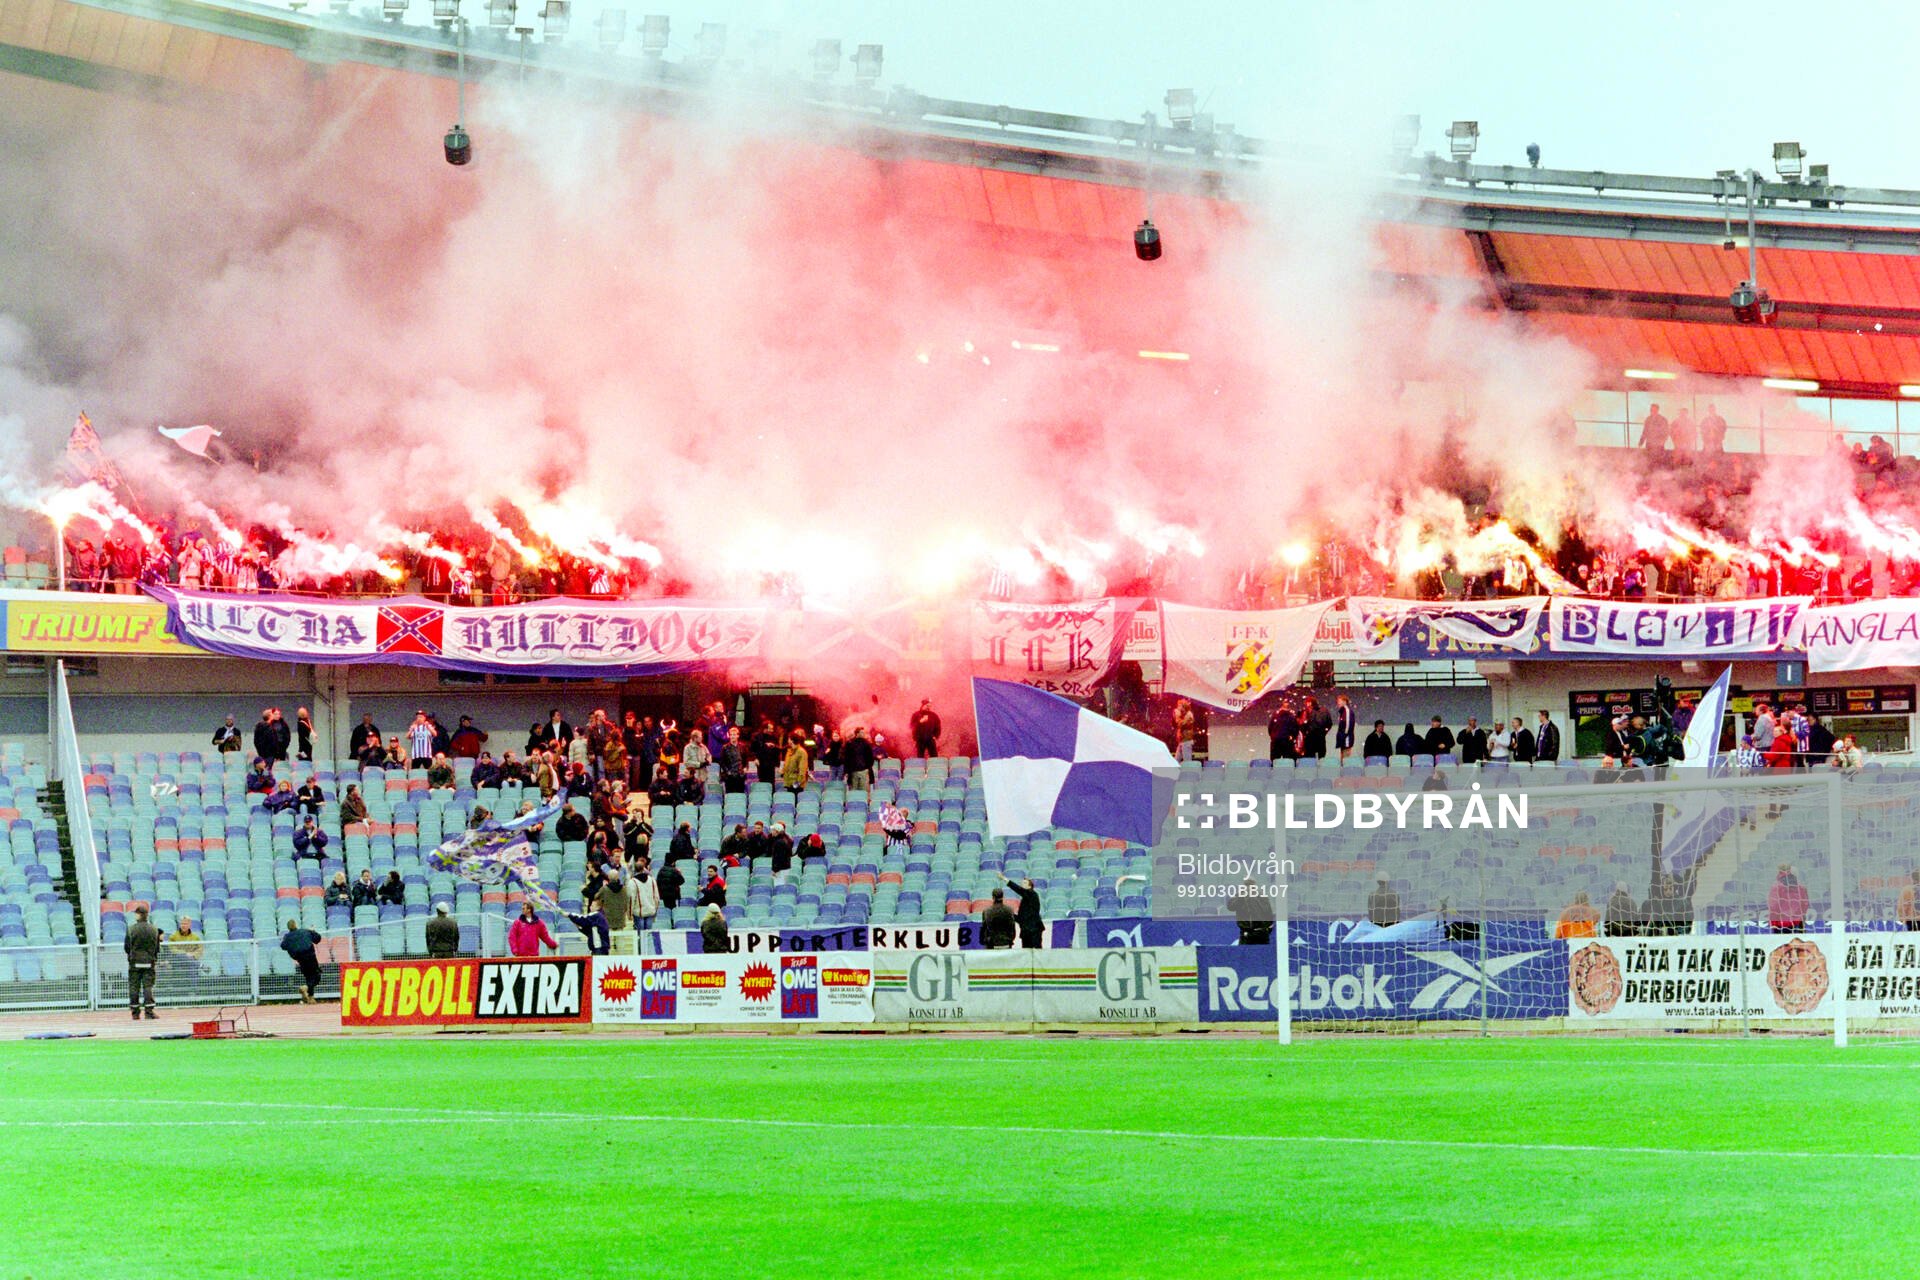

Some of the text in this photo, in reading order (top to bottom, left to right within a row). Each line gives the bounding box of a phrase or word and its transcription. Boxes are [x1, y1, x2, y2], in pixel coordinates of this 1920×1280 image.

[19, 613, 151, 643] TRIUMF
[1625, 943, 1766, 973] TÄTA TAK MED
[1845, 939, 1883, 969] ÄTA
[603, 979, 633, 990] NYHET!
[743, 977, 773, 989] NYHET!
[909, 953, 966, 1002] GF
[1098, 951, 1157, 1002] GF
[1208, 964, 1396, 1011] Reebok
[341, 962, 580, 1017] FOTBOLL EXTRA
[782, 989, 816, 1014] LÄTT
[1625, 979, 1732, 1004] DERBIGUM
[642, 992, 676, 1015] LÄTT
[909, 1007, 964, 1019] KONSULT AB
[1100, 1006, 1157, 1018] KONSULT AB
[1665, 1006, 1764, 1017] www.tata-tak.com
